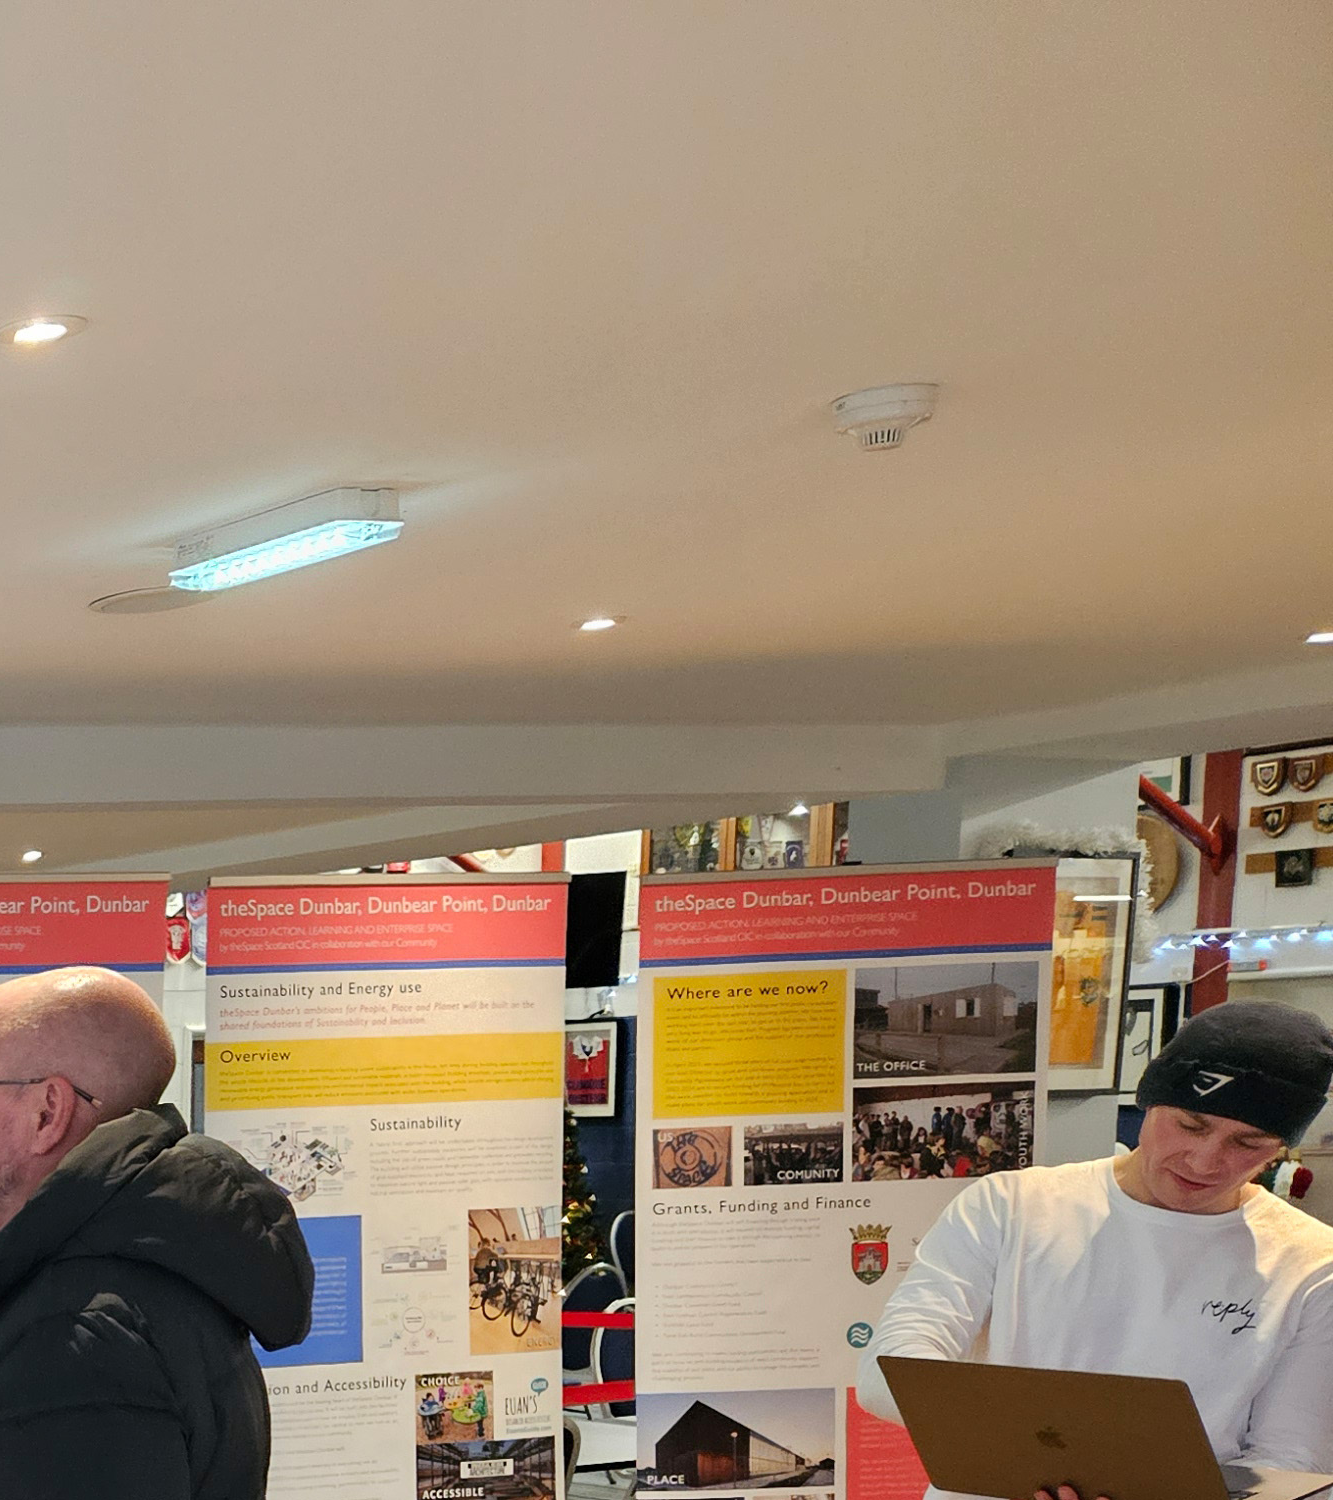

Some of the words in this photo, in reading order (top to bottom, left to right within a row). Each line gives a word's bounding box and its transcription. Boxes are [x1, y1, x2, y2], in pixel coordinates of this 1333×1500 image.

[30, 896, 80, 915] Point,
[86, 895, 149, 913] Dunbar
[654, 892, 736, 915] theSpace
[743, 889, 814, 910] Dunbar,
[821, 886, 900, 904] Dunbear
[907, 883, 961, 903] Point,
[967, 880, 1036, 898] Dunbar
[220, 899, 294, 921] theSpace
[299, 899, 363, 916] Dunbar,
[368, 896, 437, 914] Dunbear
[443, 896, 488, 914] Point,
[493, 895, 551, 912] Dunbar
[220, 983, 315, 1000] Sustainability
[320, 982, 342, 995] and
[348, 982, 394, 998] Energy
[399, 982, 422, 994] use
[667, 985, 721, 1000] Where
[727, 983, 752, 997] are
[758, 983, 780, 996] we
[785, 979, 828, 995] now?
[220, 1048, 291, 1064] Overview
[857, 1060, 879, 1072] THE
[883, 1059, 926, 1071] OFFICE
[370, 1115, 462, 1132] Sustainability
[776, 1167, 840, 1181] COMUNITY
[652, 1201, 712, 1216] Grants,
[719, 1198, 778, 1215] Funding
[784, 1196, 810, 1210] and
[816, 1195, 872, 1209] Finance
[1201, 1299, 1257, 1333] reply
[295, 1381, 319, 1394] and
[324, 1375, 407, 1393] Accessibility
[421, 1376, 460, 1386] CHOICE
[647, 1474, 684, 1485] PLACE
[422, 1487, 484, 1499] ACCESSIBLE
